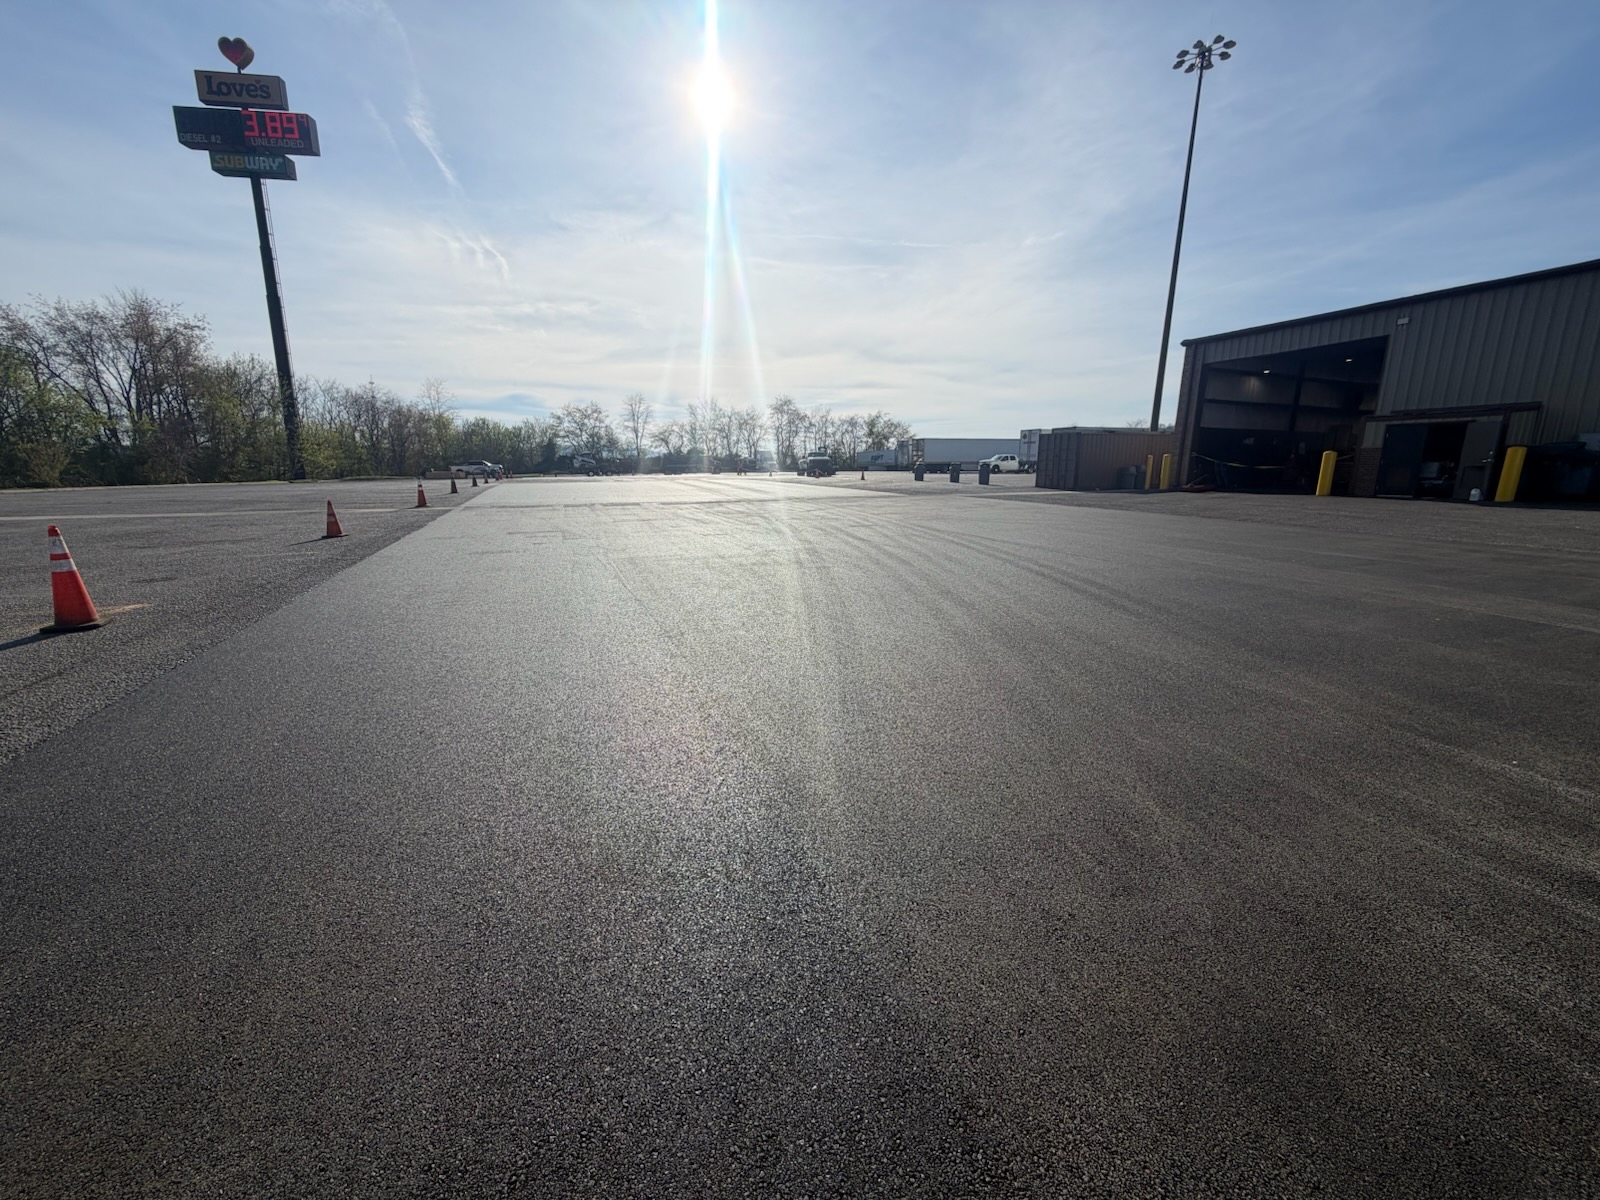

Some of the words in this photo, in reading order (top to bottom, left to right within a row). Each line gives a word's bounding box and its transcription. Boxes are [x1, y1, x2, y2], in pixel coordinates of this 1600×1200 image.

[180, 133, 208, 143] DIESEL
[211, 134, 222, 144] #2
[250, 138, 305, 149] UNLEADED
[213, 154, 283, 170] SUBWAY
